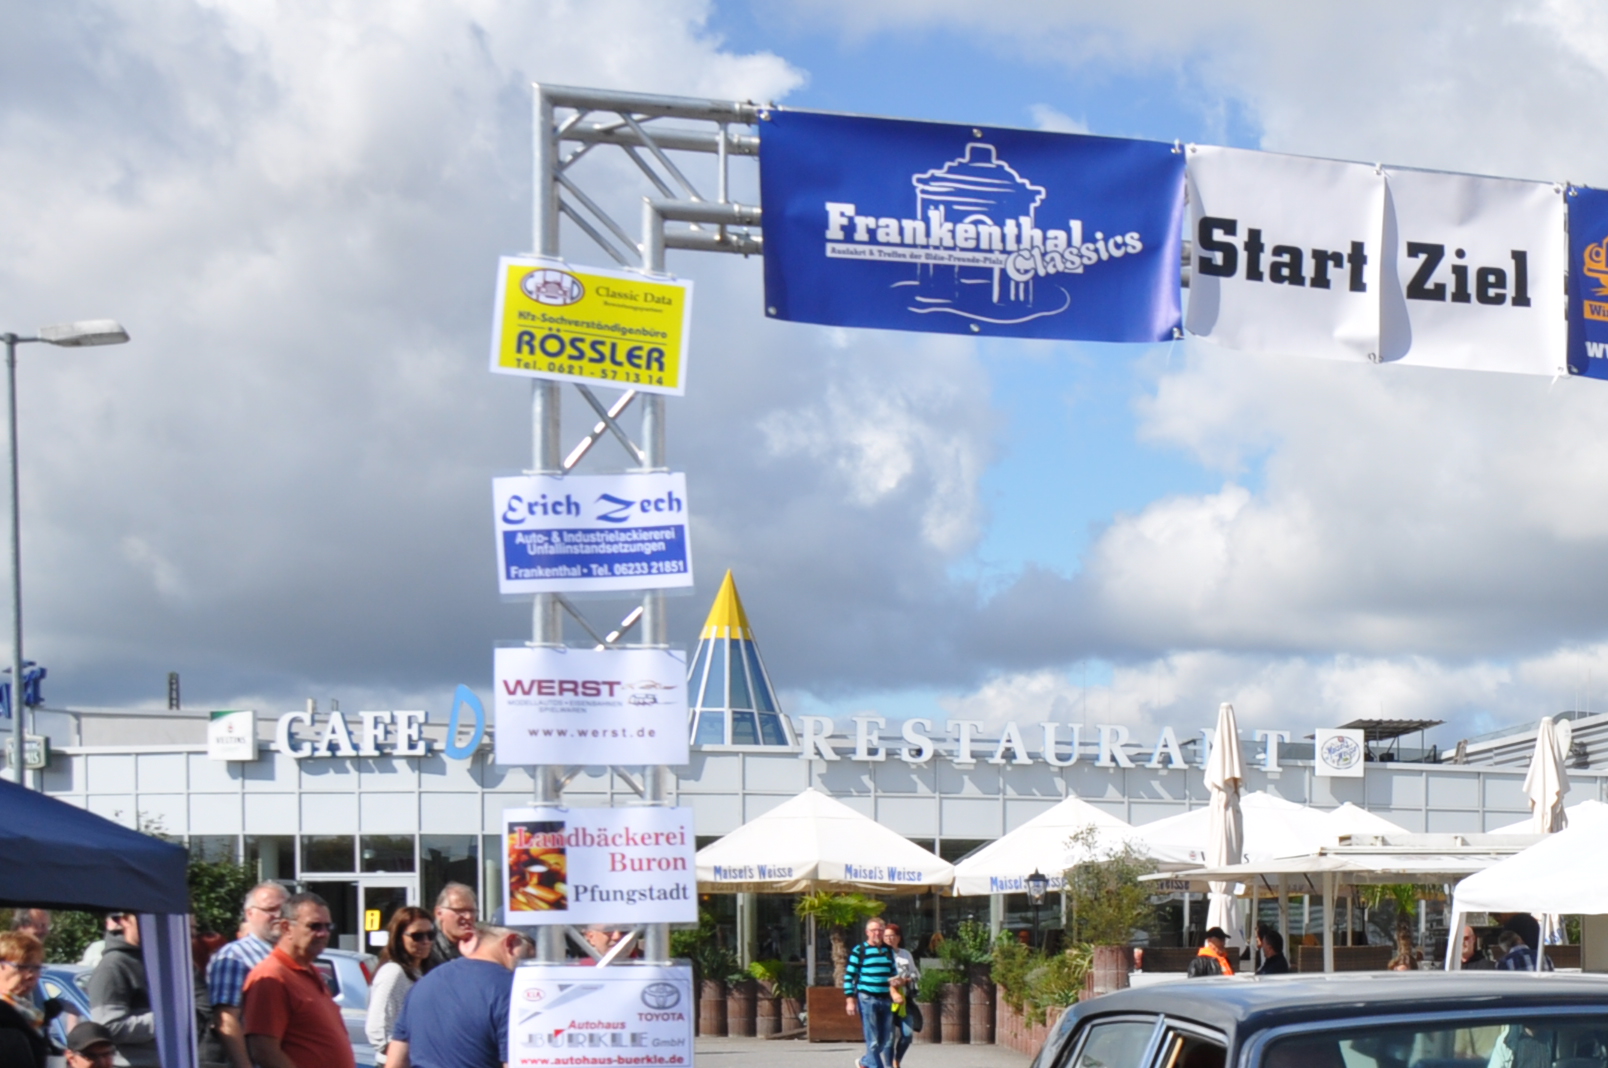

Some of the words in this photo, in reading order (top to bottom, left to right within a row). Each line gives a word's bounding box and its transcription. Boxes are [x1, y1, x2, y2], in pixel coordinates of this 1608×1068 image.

[825, 202, 1083, 254] Frankenthal
[1006, 231, 1143, 282] Classics
[1198, 216, 1368, 293] Start
[1406, 241, 1531, 307] Ziel
[595, 286, 639, 302] Classic
[643, 292, 673, 306] Data
[517, 311, 668, 339] Kfz-Sachverständigenbüro
[516, 327, 665, 373] RÖSSLER
[516, 358, 542, 372] Tel.
[548, 362, 584, 376] 0621
[601, 368, 617, 380] 57
[625, 372, 640, 383] 13
[648, 374, 664, 386] 14
[502, 493, 580, 525] Erich
[595, 491, 682, 523] Zech
[515, 532, 548, 545] Auto-
[551, 531, 560, 543] &
[563, 528, 676, 543] Industrielackiererei
[527, 541, 666, 556] Unfallinstandsetzungen
[590, 563, 611, 577] Tel.
[614, 562, 649, 576] 06233
[651, 560, 684, 574] 21851
[503, 679, 622, 698] WERST
[276, 710, 428, 758] CAFE
[528, 727, 656, 738] www.werst.de
[515, 826, 686, 849] Landbäckerei
[609, 852, 687, 873] Buron
[713, 864, 754, 881] Maisel's
[757, 864, 793, 880] Weisse
[844, 863, 884, 880] Maisel's
[888, 866, 922, 882] Weisse
[573, 883, 690, 905] Pfungstadt
[568, 1020, 627, 1030] Autohaus
[637, 1012, 685, 1022] TOYOTA
[652, 1038, 686, 1047] GmbH
[520, 1055, 685, 1066] www.autohaus-buerkle.de
